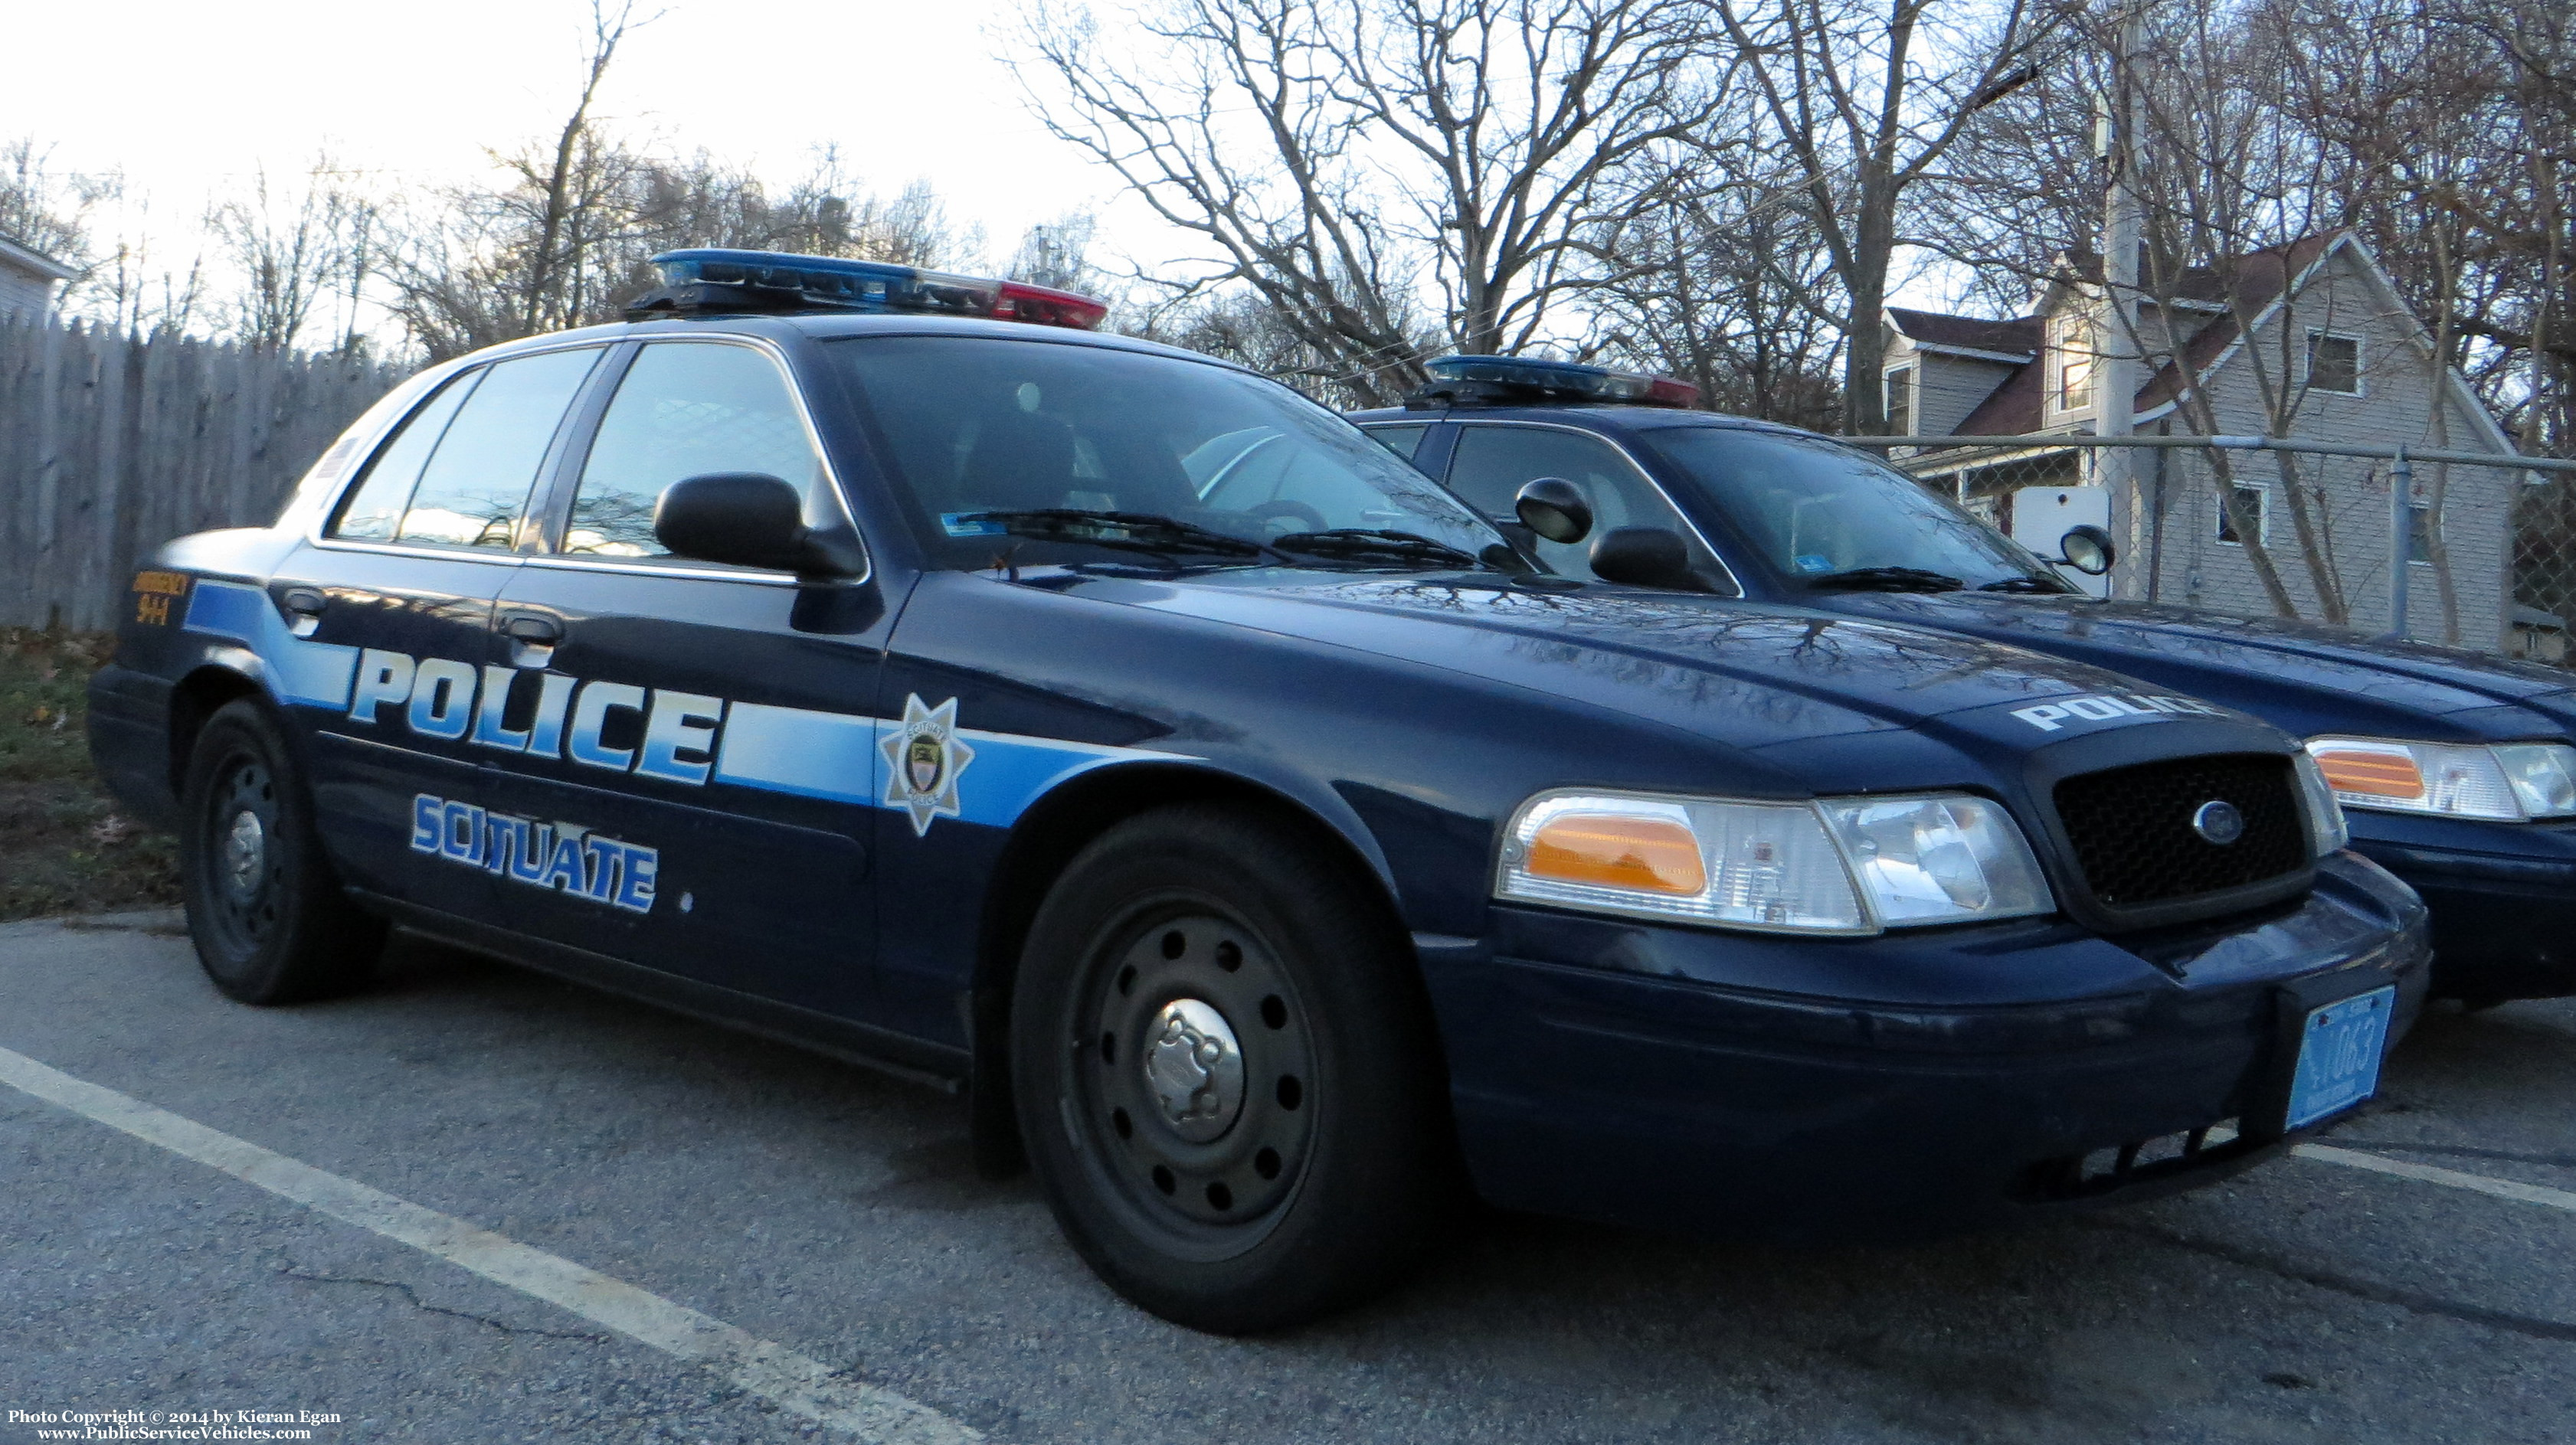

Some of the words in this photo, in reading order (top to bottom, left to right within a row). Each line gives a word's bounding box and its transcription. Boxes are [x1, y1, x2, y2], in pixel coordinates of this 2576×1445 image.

[349, 647, 723, 786] POLICE
[908, 721, 948, 741] SCITUATE
[2009, 695, 2230, 732] POLICE
[908, 788, 940, 805] POLICE
[409, 793, 658, 914] SCITUATE
